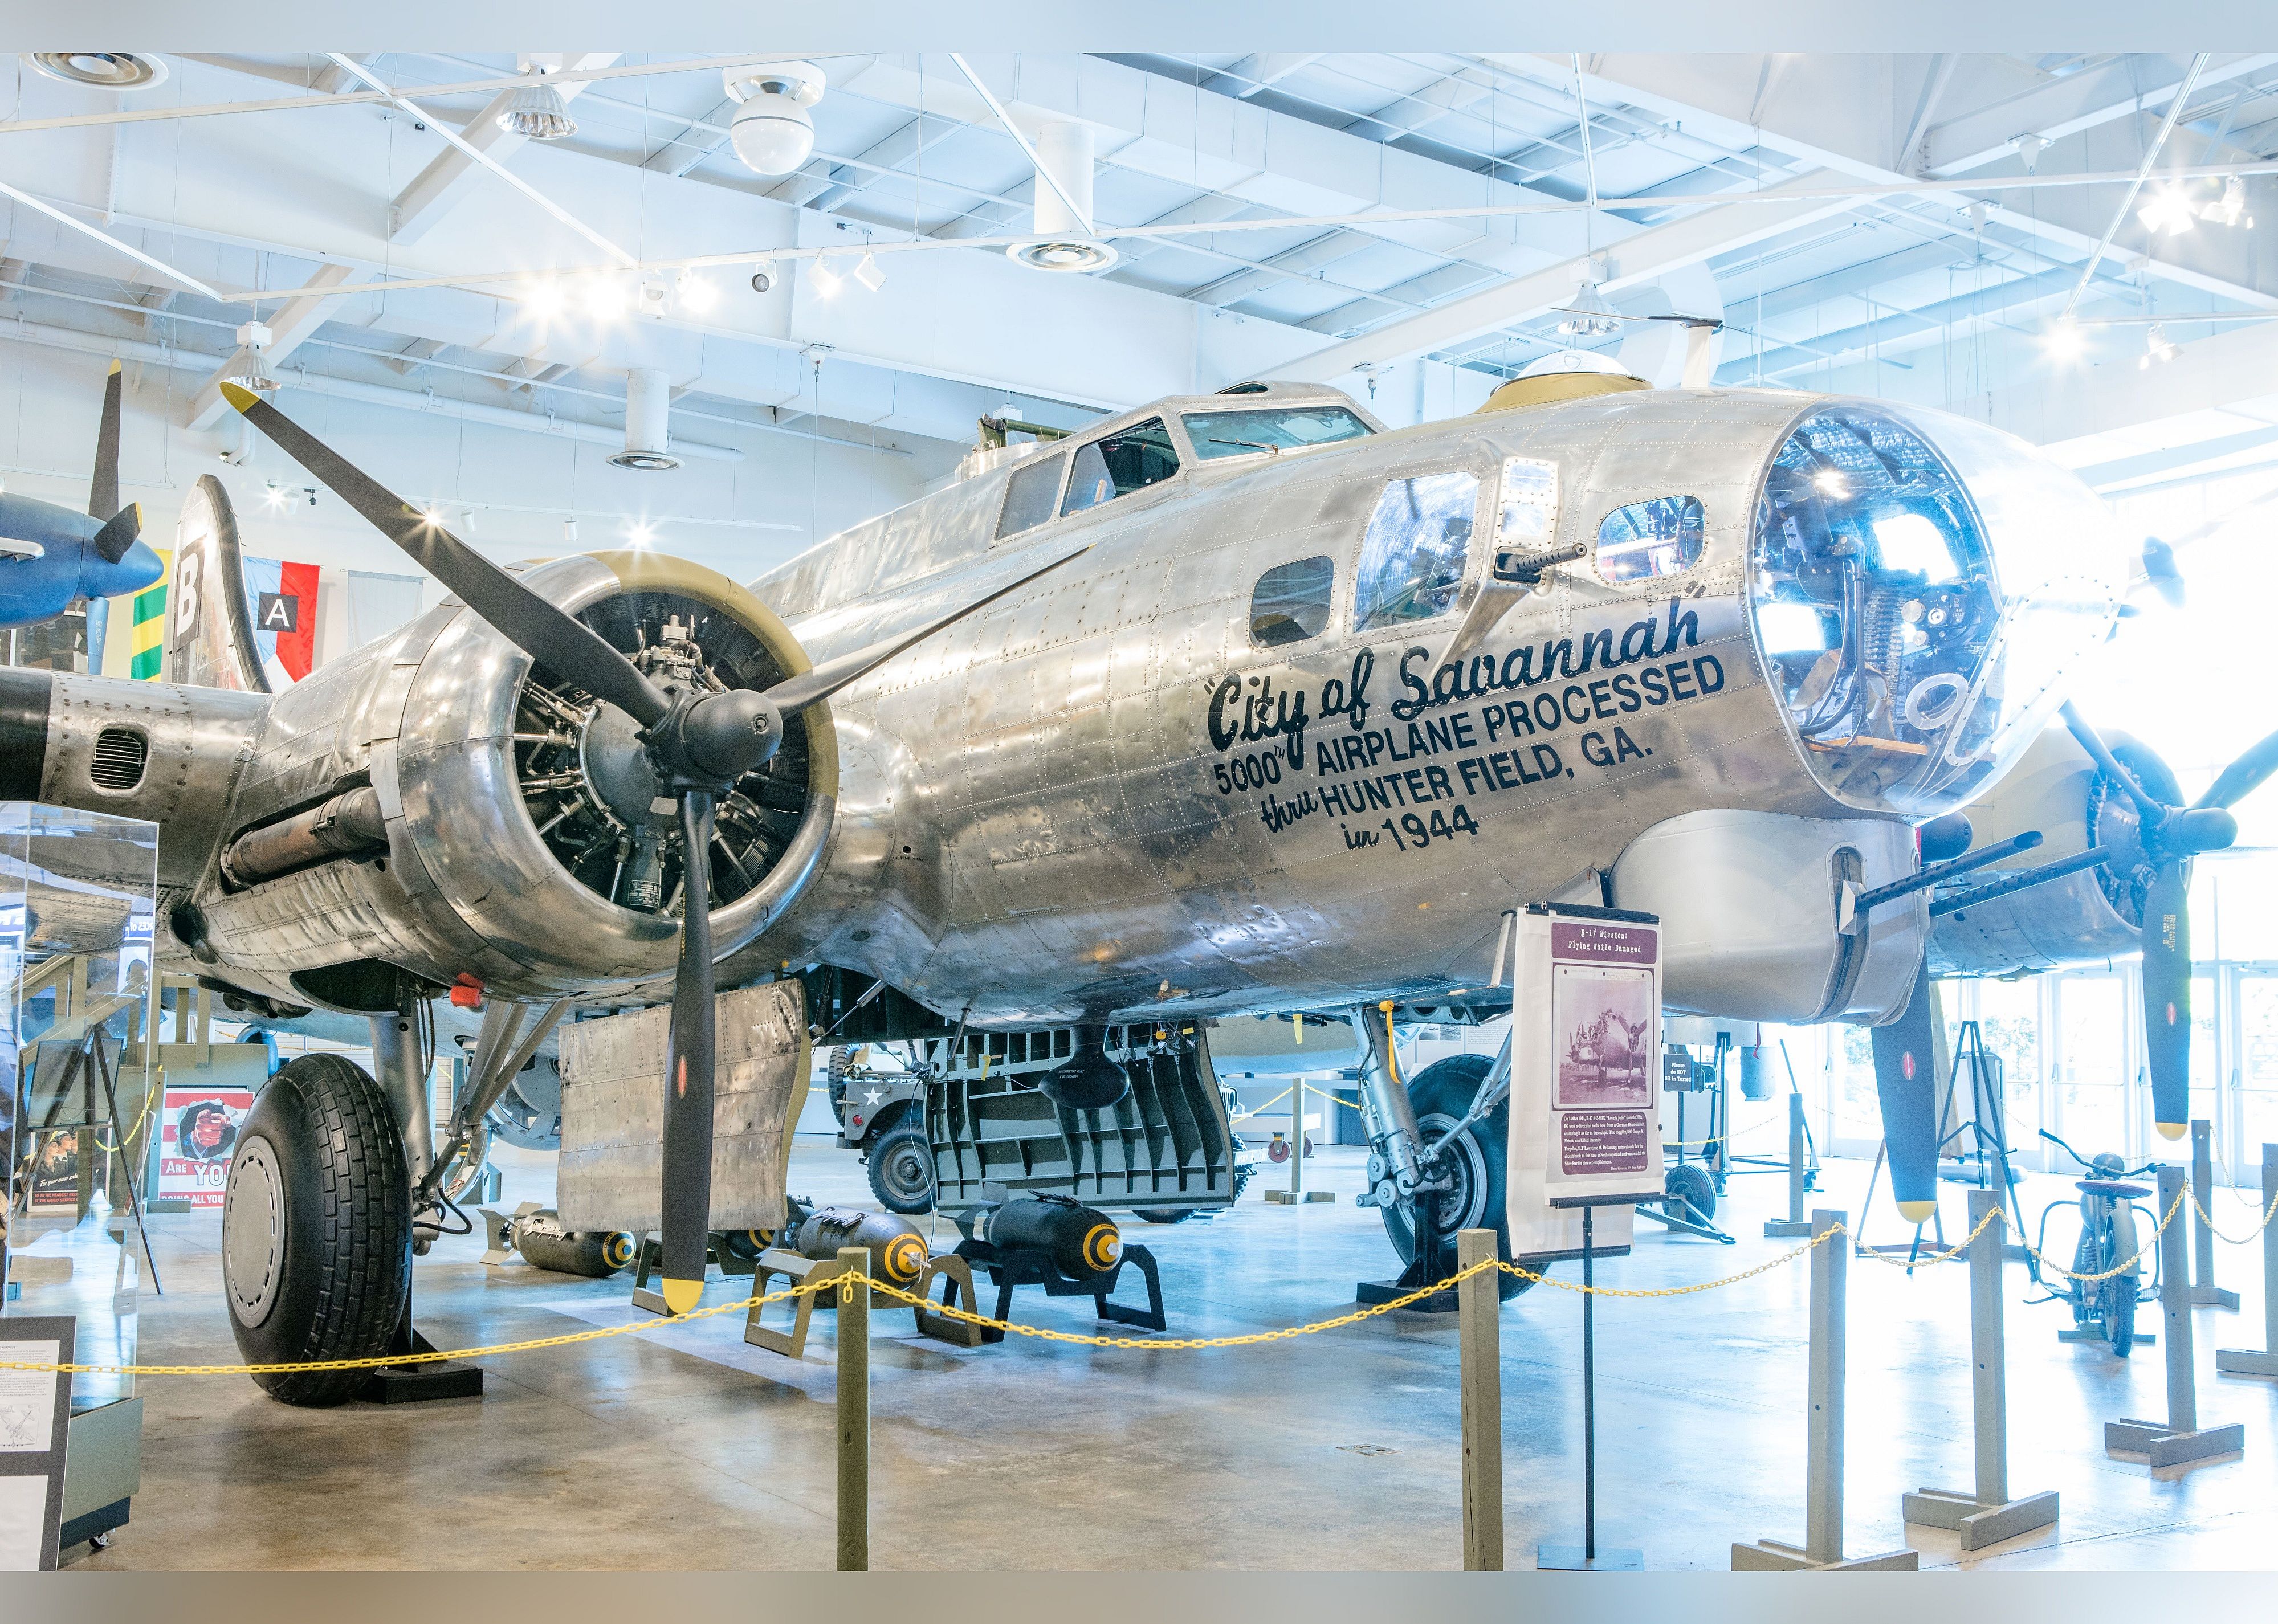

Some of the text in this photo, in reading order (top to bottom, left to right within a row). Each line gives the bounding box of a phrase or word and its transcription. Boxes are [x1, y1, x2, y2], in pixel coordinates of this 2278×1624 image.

[177, 552, 198, 638] B
[265, 599, 290, 628] A
[1204, 673, 1309, 771] "City
[1318, 646, 1375, 732] of
[1317, 712, 1478, 777] AIRPLANE
[1482, 654, 1725, 742] PROCESSED
[1260, 725, 1653, 833] thru HUNTER FIELD, GA.
[1341, 803, 1480, 851] in 1944
[1568, 940, 1641, 954] Flying While Damaged
[1580, 928, 1627, 939] B-17 Mission:
[193, 1164, 231, 1186] YO
[191, 1195, 206, 1204] ALL
[206, 1194, 224, 1204] YOU
[890, 1237, 901, 1247] COMP
